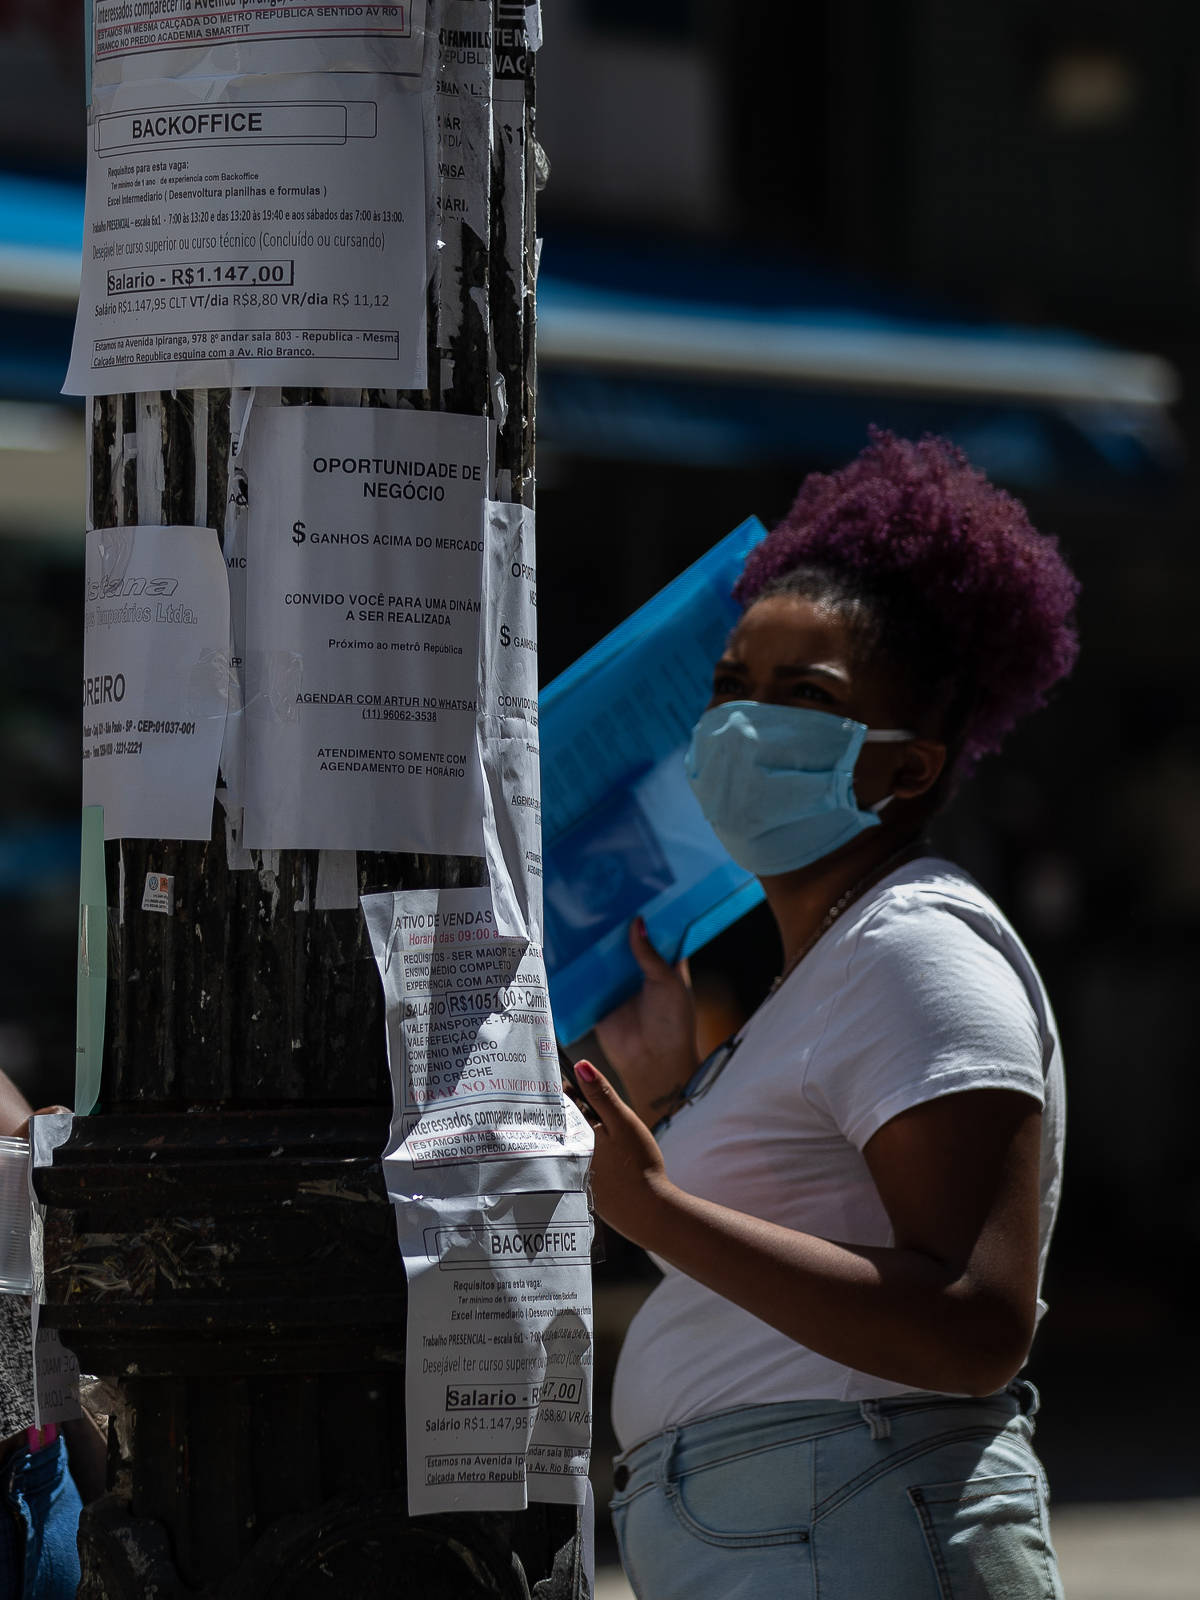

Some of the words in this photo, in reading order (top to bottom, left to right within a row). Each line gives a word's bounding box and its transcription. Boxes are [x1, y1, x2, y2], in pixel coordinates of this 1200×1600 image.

[97, 2, 133, 24] Interessados
[97, 26, 123, 41] ESTAMOS
[134, 20, 158, 34] MESMA
[160, 15, 201, 31] CALÇADA
[203, 14, 218, 25] DO
[220, 11, 253, 24] METRO
[256, 8, 313, 20] REPUBLICA
[317, 7, 362, 17] SENTIDO
[366, 7, 379, 18] AV
[383, 7, 399, 17] RIO
[97, 39, 119, 53] BRANCO
[131, 34, 156, 46] PREDIO
[157, 30, 203, 43] ACADEMIA
[205, 24, 250, 37] SMARTFIT
[132, 112, 263, 139] BACKOFFICE
[107, 165, 135, 179] Requisitos
[136, 164, 151, 176] para
[152, 162, 168, 172] esta
[169, 161, 189, 173] vaga:
[204, 174, 220, 183] com
[221, 172, 260, 181] Backoffice
[121, 190, 163, 205] Intermediario
[169, 187, 223, 201] Desenvoltura
[225, 185, 267, 199] planilhas
[277, 185, 321, 197] formulas
[191, 210, 209, 223] 13:20
[216, 209, 229, 222] das
[230, 209, 251, 222] 13:20
[263, 209, 284, 221] 19:40
[306, 208, 338, 221] sábados
[340, 209, 353, 221] das
[355, 209, 372, 222] 7:00
[145, 237, 177, 256] superior
[179, 239, 190, 250] ou
[191, 238, 218, 251] curso
[219, 232, 257, 249] técnico
[259, 231, 314, 252] (Concluído
[316, 236, 331, 248] ou
[333, 231, 385, 253] cursando)
[109, 272, 156, 292] Salario
[94, 304, 117, 317] Salário
[118, 297, 167, 315] R$1.147,95
[169, 296, 188, 309] CLT
[189, 293, 229, 309] VT/dia
[233, 292, 279, 308] R$8,80
[281, 291, 329, 307] VR/dia
[333, 292, 351, 307] R$
[353, 293, 390, 308] 11,12
[125, 337, 154, 349] Avenida
[155, 335, 191, 348] Ipiranga,
[191, 333, 208, 344] 978
[220, 331, 249, 342] andar
[251, 331, 272, 342] sala
[275, 331, 293, 342] 803
[302, 331, 354, 344] Republica
[116, 353, 134, 365] Metro
[136, 350, 172, 363] Republica
[173, 348, 206, 361] esquina
[208, 348, 227, 359] com
[236, 347, 254, 358] Av.
[257, 347, 274, 357] Rio
[275, 347, 316, 357] Branco.
[313, 457, 459, 481] OPORTUNIDADE
[461, 464, 482, 482] DE
[363, 480, 446, 502] NEGÓCIO
[310, 532, 370, 546] GANHOS
[373, 534, 413, 548] ACIMA
[416, 536, 433, 549] DO
[435, 538, 485, 552] MERCADO
[285, 592, 345, 606] CONVIDO
[349, 592, 386, 607] VOCÊ
[388, 595, 423, 609] PARA
[425, 597, 447, 611] UMA
[154, 602, 199, 625] Ltda.
[345, 610, 356, 622] A
[359, 610, 385, 623] SER
[387, 612, 452, 626] REALIZADA
[328, 638, 374, 650] Próximo
[376, 641, 389, 651] ao
[390, 640, 421, 652] metrô
[423, 640, 464, 655] República
[295, 692, 354, 705] AGENDAR
[356, 694, 382, 706] COM
[384, 695, 421, 708] ARTUR
[423, 697, 437, 708] NO
[362, 709, 382, 722] (11)
[383, 710, 438, 723] 96062-3538
[125, 719, 133, 732] SP
[317, 748, 397, 761] ATENDIMENTO
[398, 751, 445, 763] SOMENTE
[446, 754, 468, 765] COM
[320, 762, 406, 775] AGENDAMENTO
[407, 764, 423, 776] DE
[425, 766, 466, 779] HORÁRIO
[394, 914, 426, 931] ATIVO
[427, 914, 441, 929] DE
[442, 909, 493, 927] VENDAS
[409, 931, 437, 947] Horario
[439, 930, 456, 944] das
[457, 928, 490, 942] 09:00
[403, 952, 445, 966] REQUISITOS
[451, 950, 474, 964] SER
[404, 967, 431, 979] ENSINO
[430, 964, 458, 978] MEDIO
[459, 959, 512, 974] COMPLETO
[406, 979, 454, 992] EXPERIENCIA
[456, 975, 483, 988] COM
[406, 1000, 446, 1019] SALARIO
[406, 1022, 425, 1035] VALE
[407, 1036, 425, 1049] VALE
[408, 1048, 450, 1062] CONVENIO
[452, 1039, 499, 1057] MÉDICO
[408, 1061, 453, 1075] CONVENIO
[455, 1051, 527, 1070] ODONTOLOGICO
[408, 1075, 441, 1088] AUXILIO
[443, 1066, 494, 1084] CRECHE
[412, 1135, 461, 1151] ESTAMOS
[462, 1134, 477, 1145] NA
[416, 1147, 459, 1161] BRANCO
[460, 1145, 475, 1157] NO
[491, 1231, 578, 1256] BACKOFFICE
[453, 1280, 495, 1294] Requisitos
[496, 1280, 512, 1292] para
[451, 1310, 473, 1321] Excel
[474, 1308, 526, 1321] Intermediario
[422, 1334, 448, 1349] Trabalho
[448, 1333, 487, 1348] PRESENCIAL
[493, 1332, 514, 1345] escala
[422, 1356, 462, 1376] Desejável
[463, 1358, 476, 1371] ter
[479, 1358, 505, 1371] curso
[448, 1388, 518, 1407] Salario
[425, 1418, 462, 1433] Salário
[464, 1415, 528, 1433] R$1.147,95
[427, 1456, 460, 1470] Estamos
[461, 1457, 473, 1466] na
[474, 1455, 514, 1467] Avenida
[426, 1471, 456, 1486] Calçada
[457, 1470, 488, 1482] Metro
